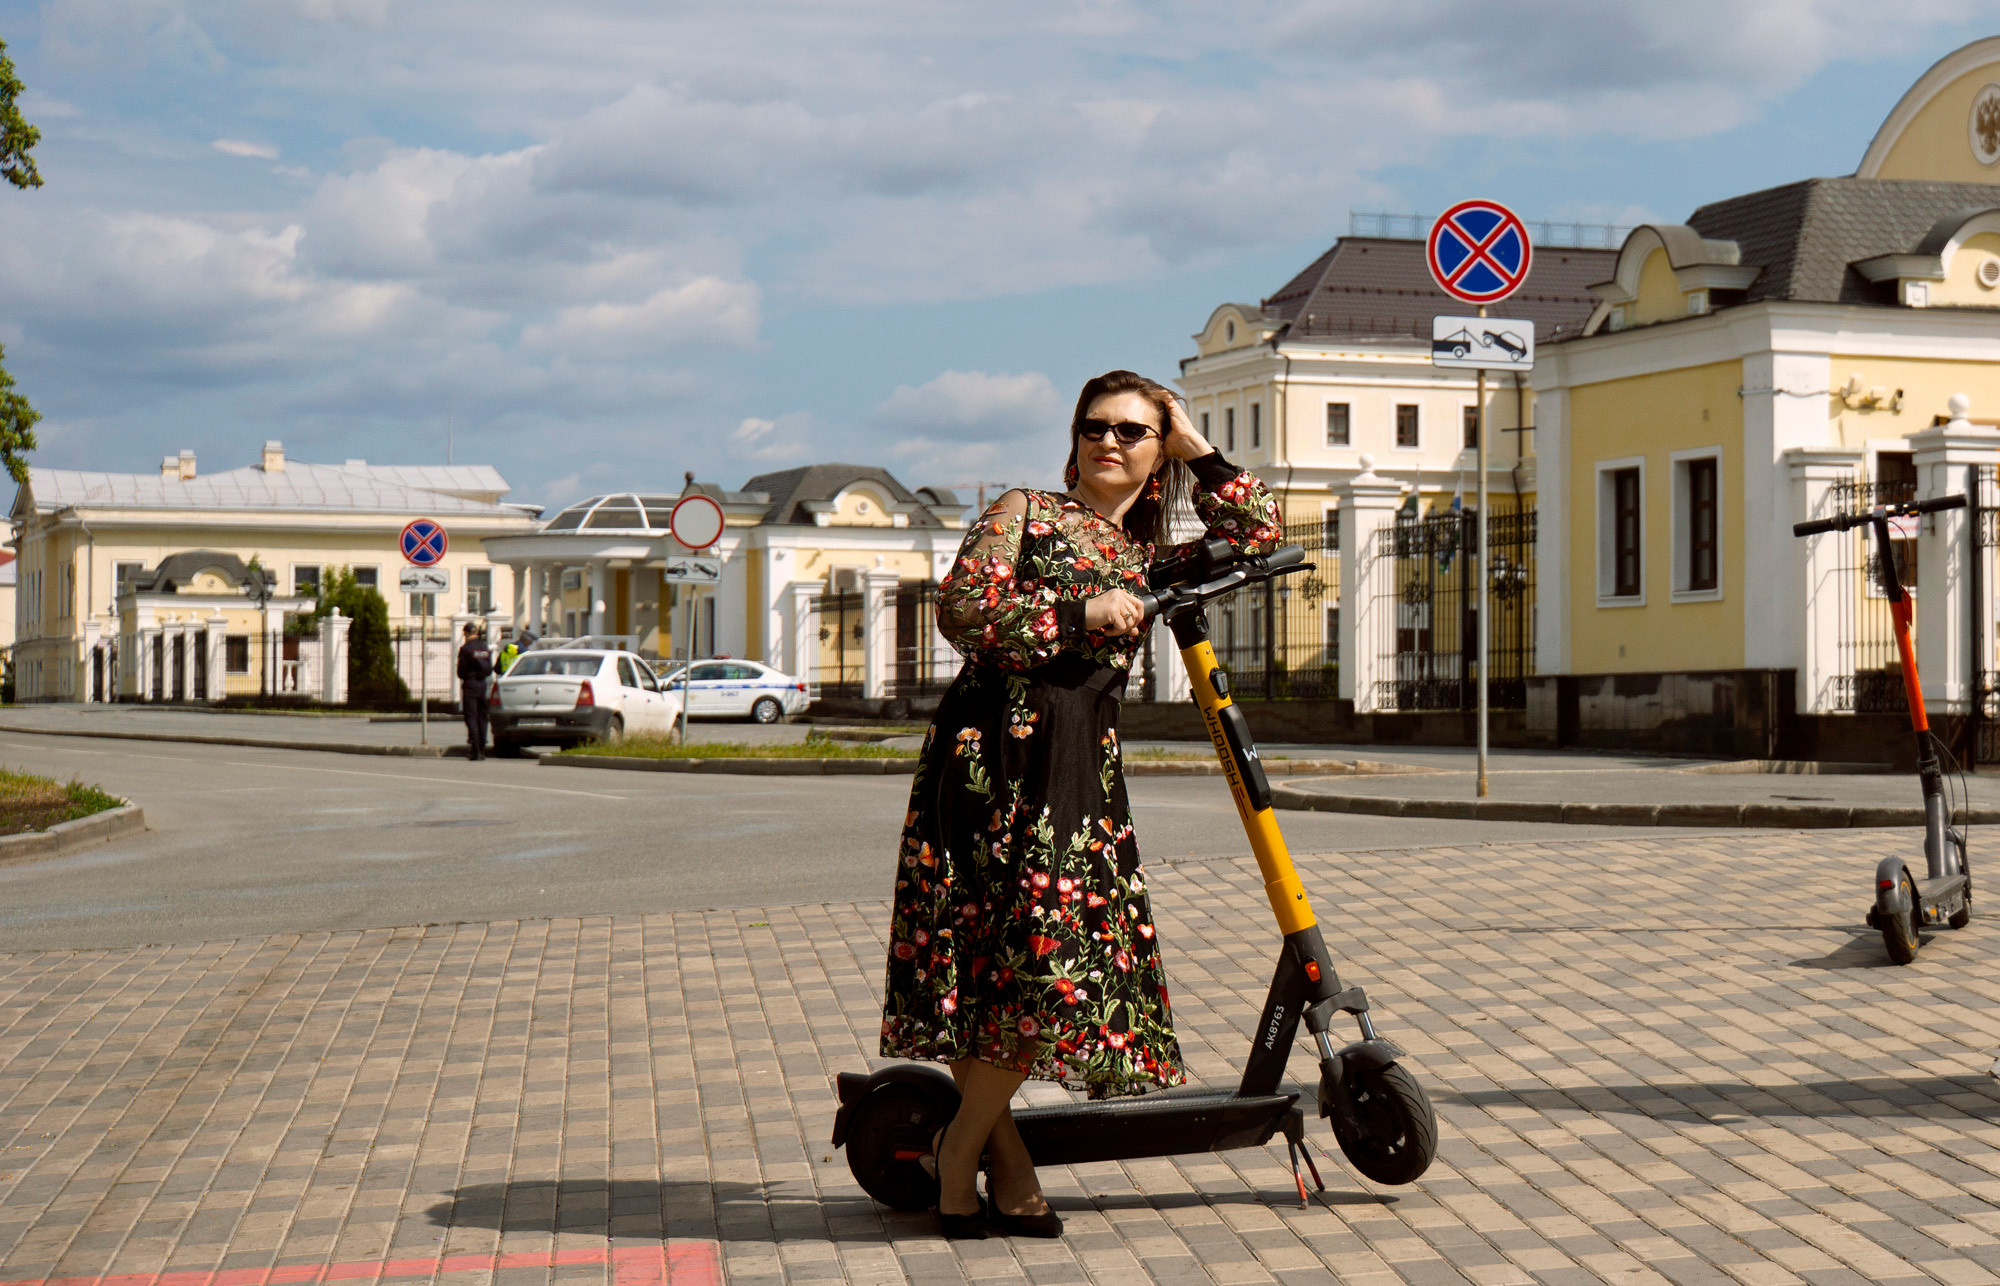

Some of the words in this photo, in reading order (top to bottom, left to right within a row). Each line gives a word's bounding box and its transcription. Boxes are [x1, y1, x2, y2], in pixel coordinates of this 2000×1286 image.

[1204, 706, 1240, 786] WHOOSH
[1243, 744, 1258, 762] W
[1265, 1005, 1285, 1050] AK8763
